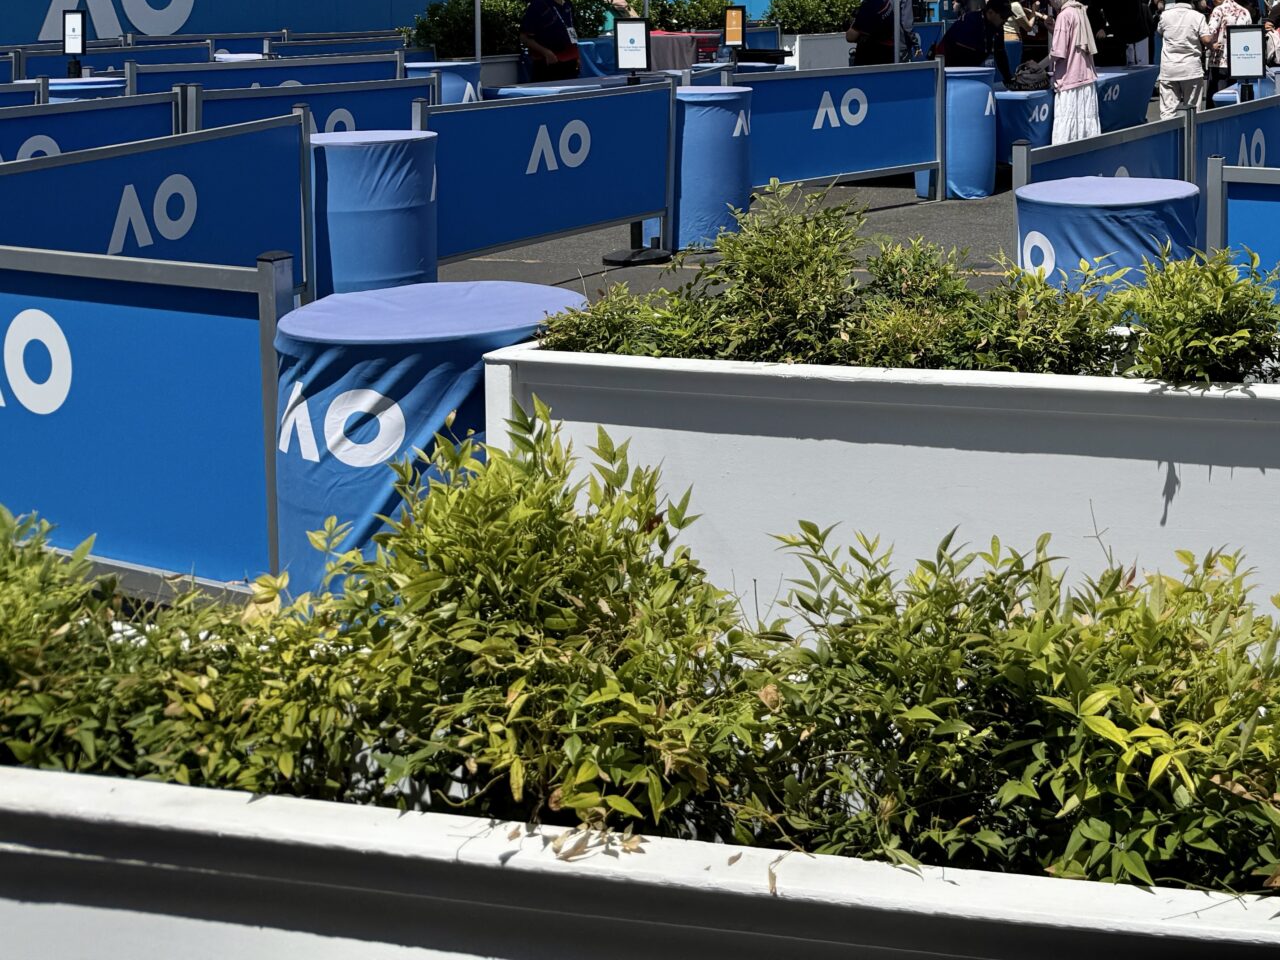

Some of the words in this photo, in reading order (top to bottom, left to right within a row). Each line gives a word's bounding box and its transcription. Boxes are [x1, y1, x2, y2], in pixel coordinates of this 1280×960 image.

[811, 88, 868, 129] AO
[1029, 103, 1049, 123] AO
[526, 119, 591, 175] AO
[1237, 128, 1266, 167] AO
[107, 174, 198, 255] AO
[279, 381, 406, 468] AO
